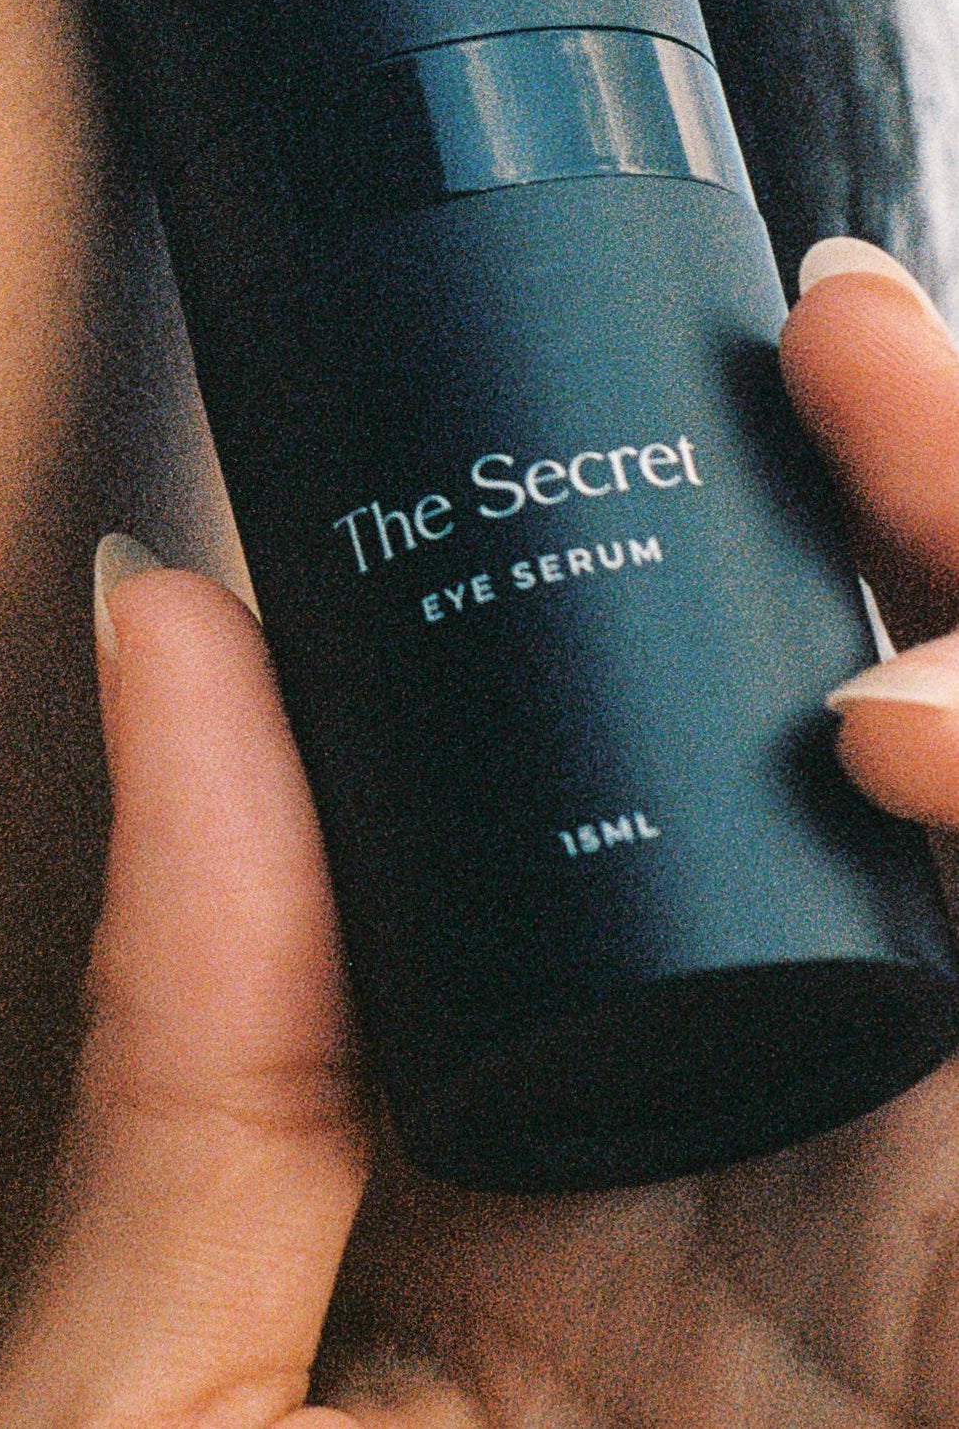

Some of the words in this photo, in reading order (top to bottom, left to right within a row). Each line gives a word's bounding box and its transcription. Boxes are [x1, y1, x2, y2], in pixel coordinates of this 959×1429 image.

[333, 494, 455, 572] The
[471, 434, 702, 519] Secret
[420, 573, 497, 622] EYE
[511, 536, 664, 591] SERUM
[558, 810, 661, 859] 15ML
